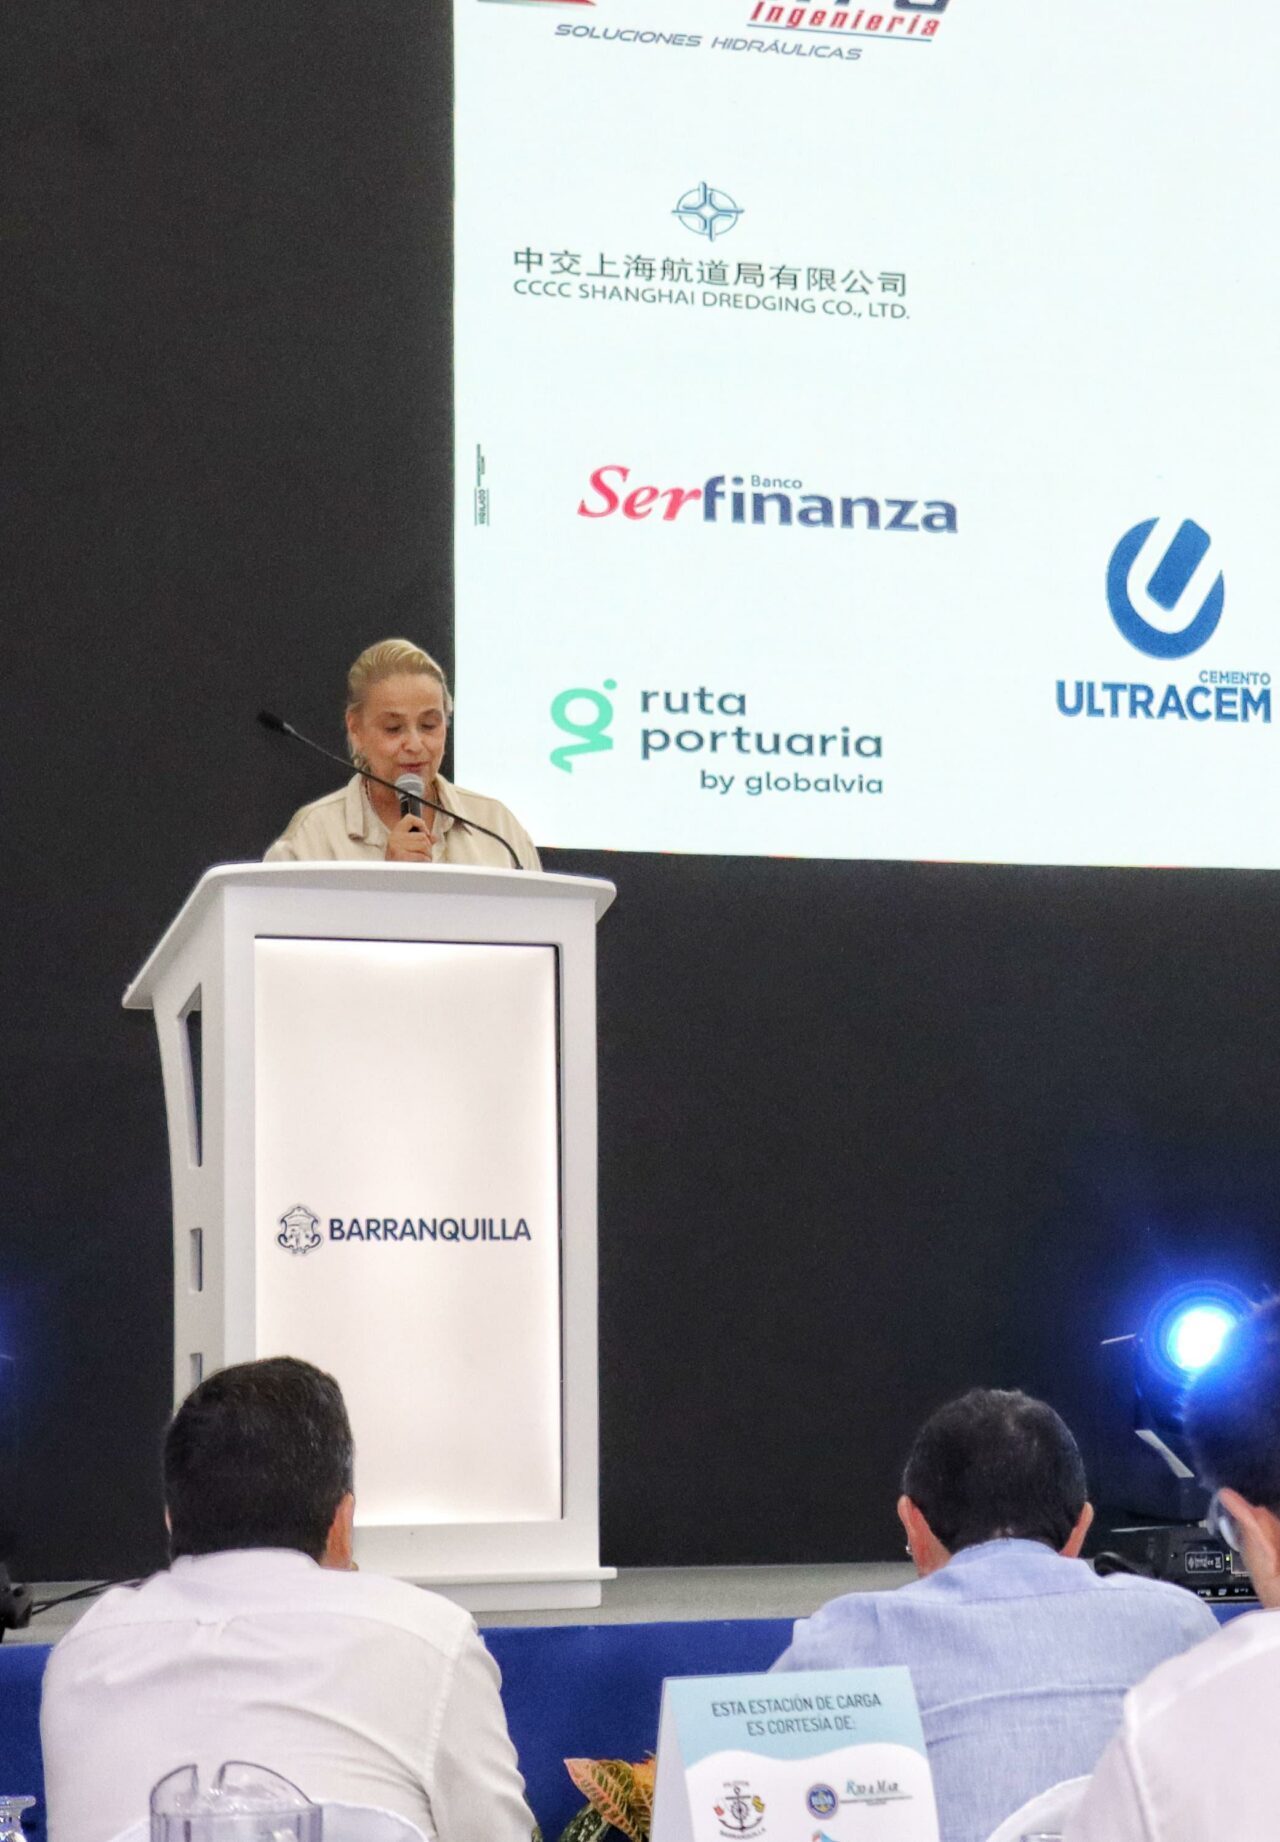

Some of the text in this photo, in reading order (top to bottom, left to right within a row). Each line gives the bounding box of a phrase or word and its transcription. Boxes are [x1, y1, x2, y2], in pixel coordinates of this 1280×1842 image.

[555, 24, 863, 61] SOLUCIONES HIDRÁULICAS
[513, 246, 908, 298] 中交上海航道局有限公司
[513, 279, 911, 319] CCCC SHANGHAI DREDGING CO., LTD.
[751, 474, 803, 489] Banco
[577, 464, 958, 534] Serfinanza
[1198, 669, 1272, 687] CEMENTO
[640, 686, 747, 716] ruta
[1056, 680, 1272, 724] ULTRACEM
[640, 726, 883, 760] portuaria
[701, 769, 883, 796] by globalvia
[329, 1218, 531, 1243] BARRANQUILLA
[711, 1693, 882, 1717] ESTA ESTACIÓN DE CARGA
[747, 1720, 765, 1736] ES
[767, 1714, 832, 1735] CORTESÍA
